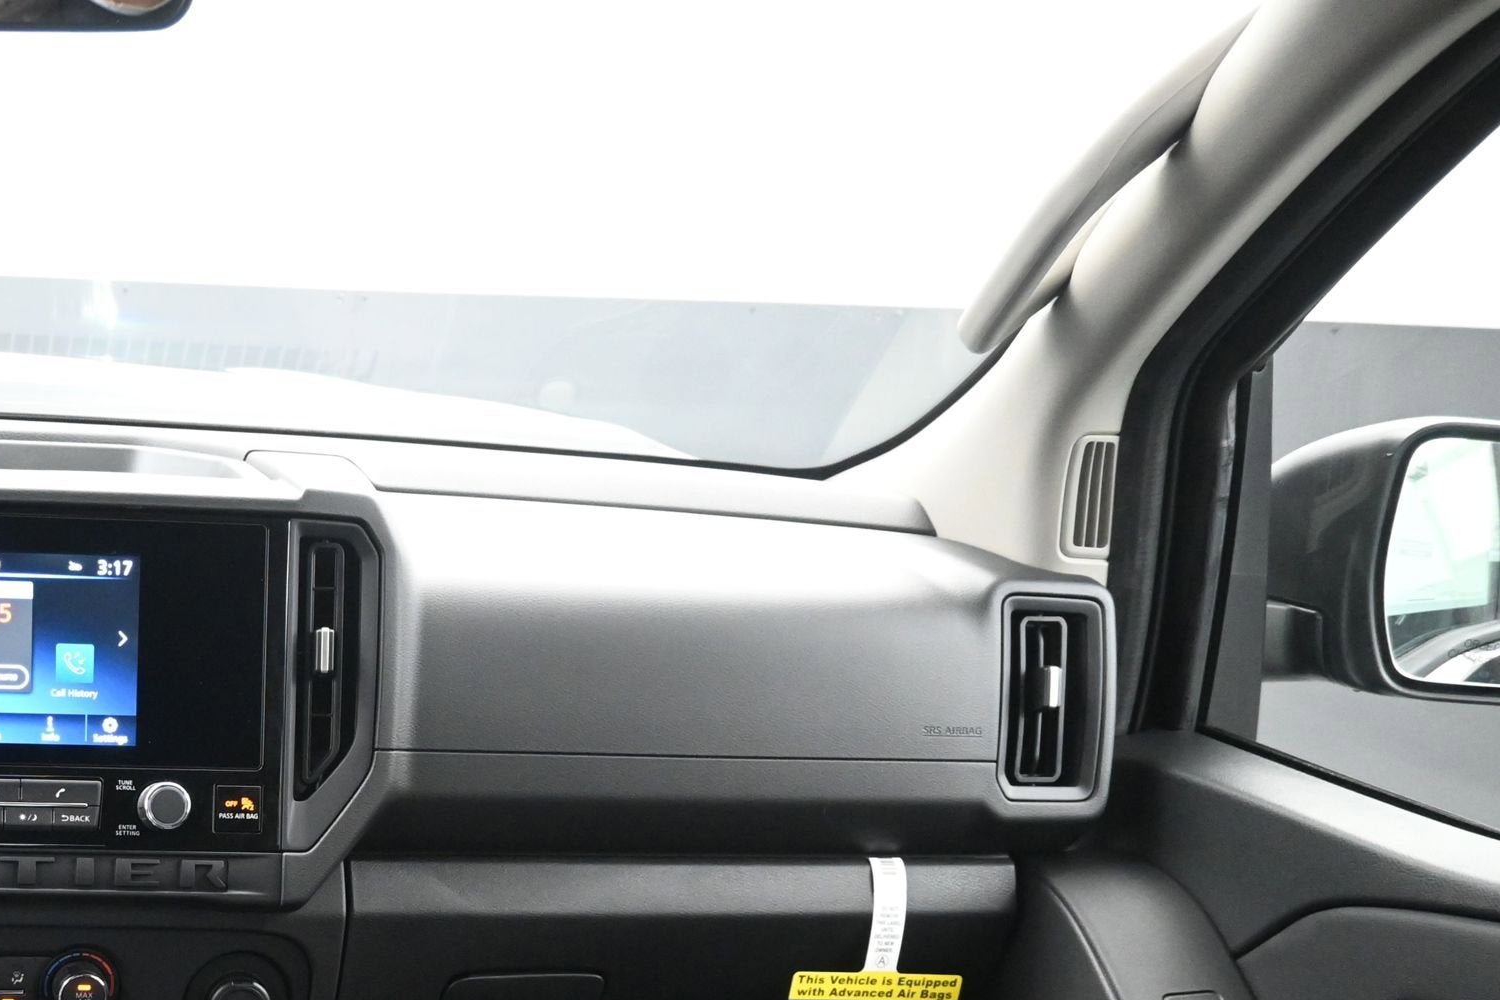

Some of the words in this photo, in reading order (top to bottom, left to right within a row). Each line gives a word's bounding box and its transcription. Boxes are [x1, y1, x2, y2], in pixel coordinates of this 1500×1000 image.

[97, 559, 133, 576] 3:17
[50, 688, 66, 698] Call
[67, 688, 98, 700] History
[922, 726, 941, 735] SRS
[69, 814, 90, 823] BACK
[798, 975, 825, 984] This
[830, 975, 878, 986] Vehicle
[882, 976, 892, 985] is
[898, 977, 958, 988] Equipped
[797, 987, 825, 997] with
[829, 987, 893, 998] Advanced
[897, 989, 916, 998] Air
[920, 989, 953, 1000] Bags
